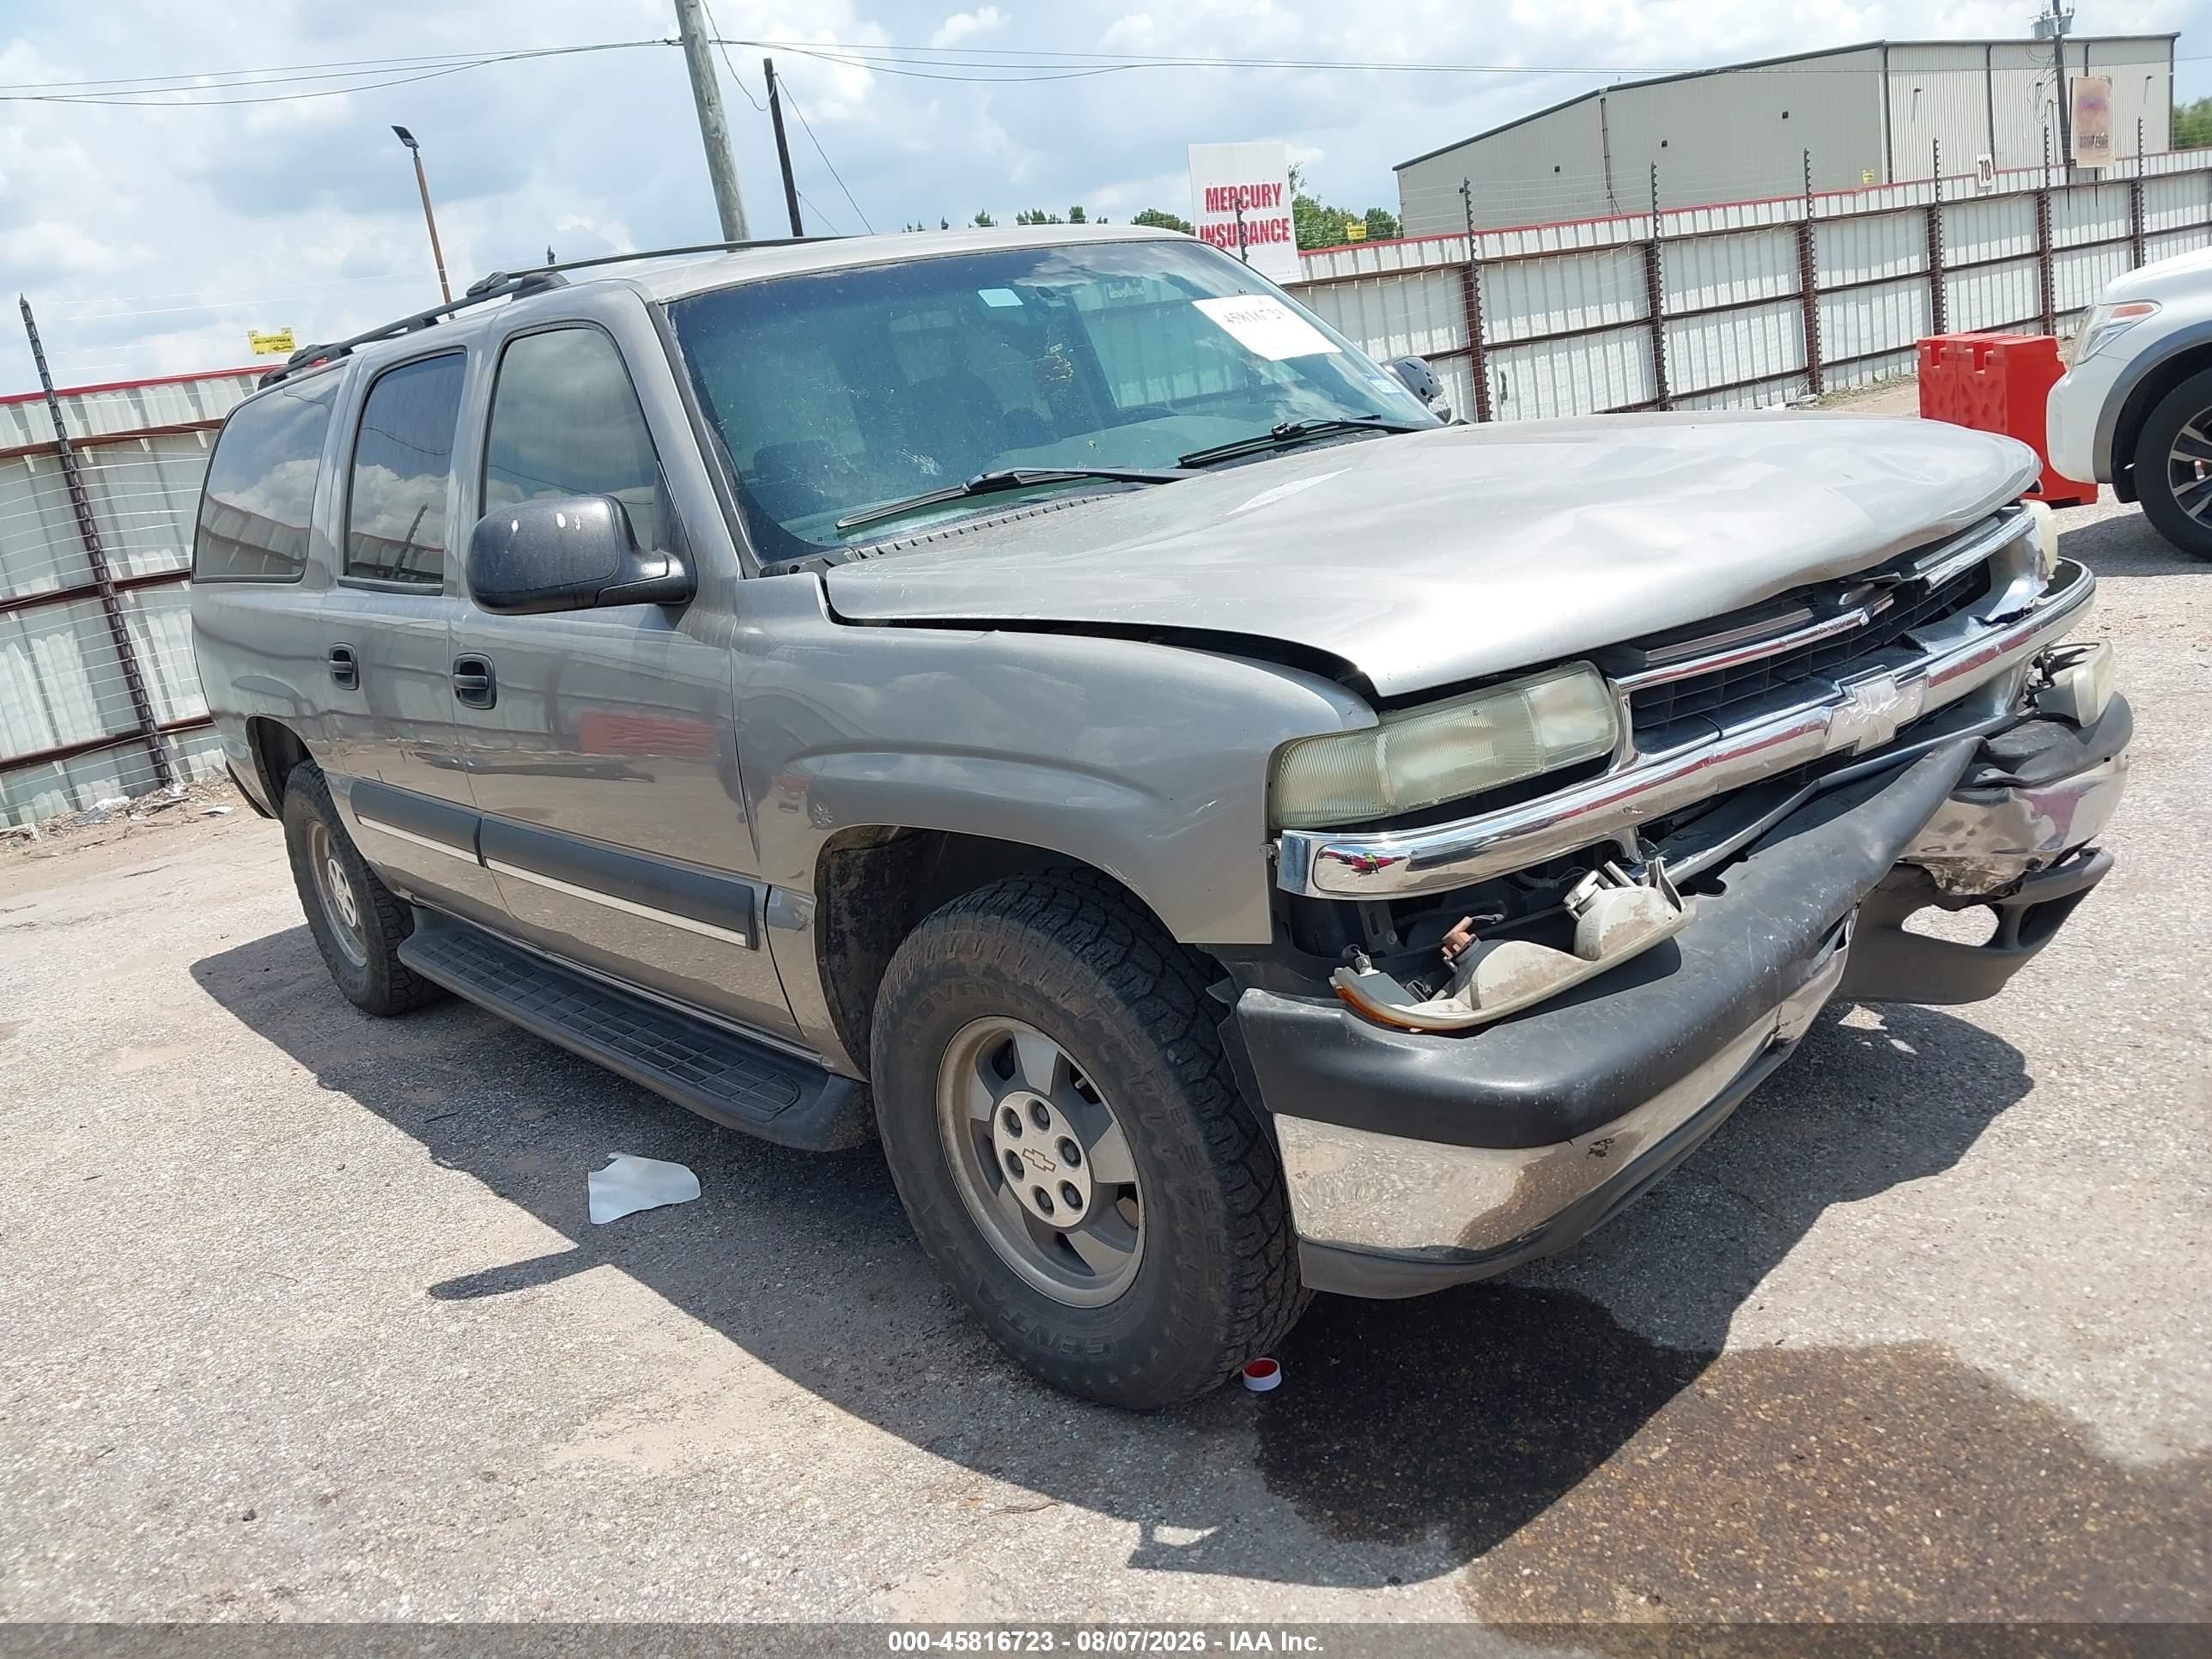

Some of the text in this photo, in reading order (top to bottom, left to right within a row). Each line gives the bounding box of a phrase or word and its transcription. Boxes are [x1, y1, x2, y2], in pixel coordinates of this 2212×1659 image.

[1978, 160, 1991, 182] 70
[1205, 183, 1283, 212] MERCURY
[1199, 217, 1291, 249] INSURANCE
